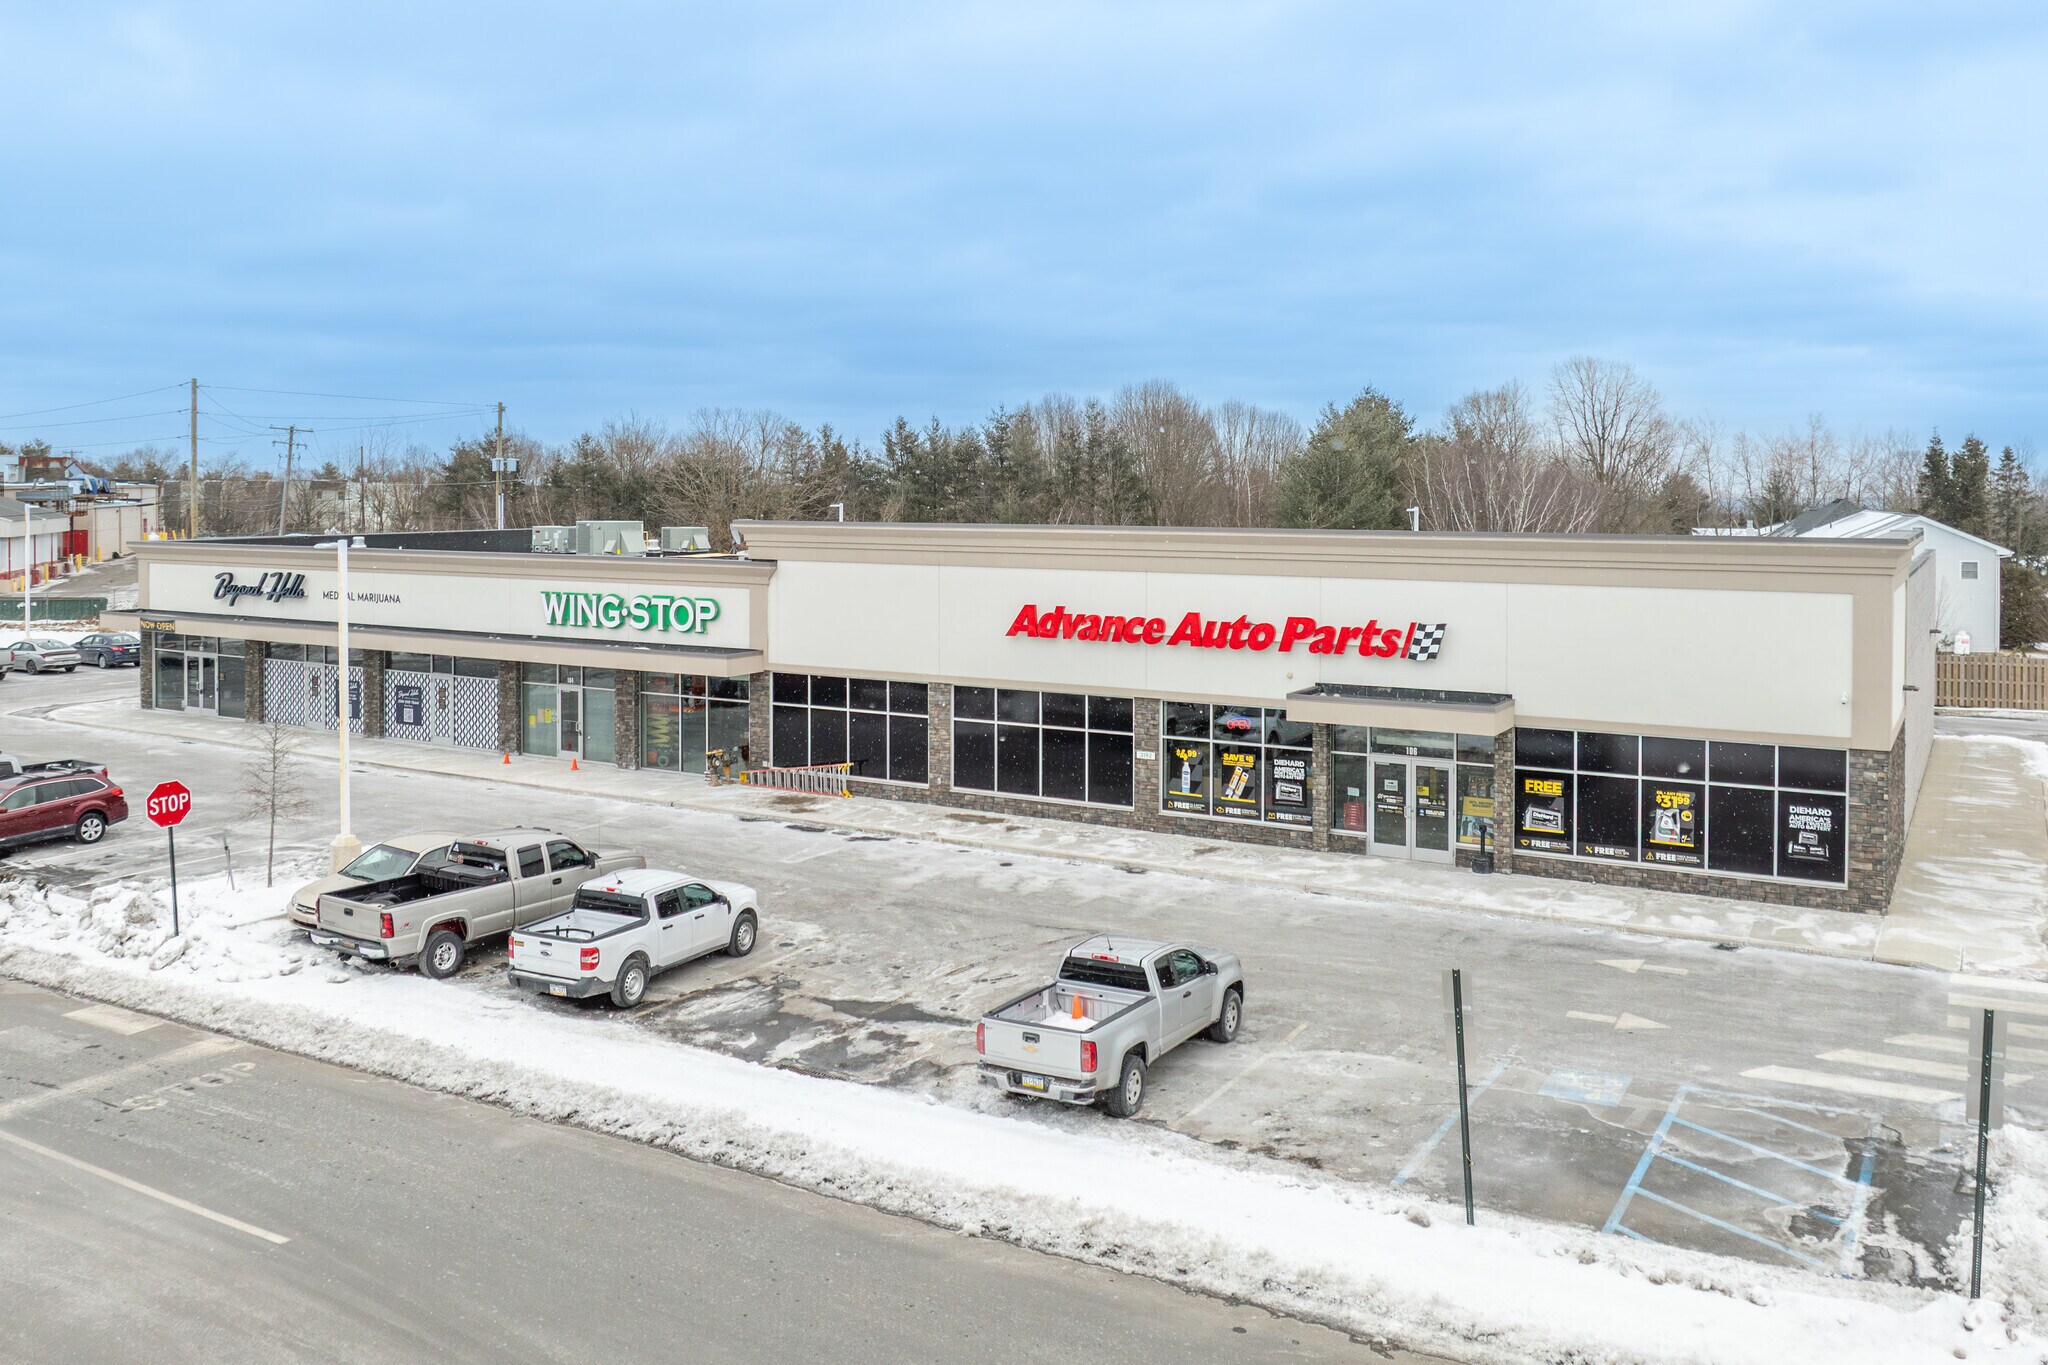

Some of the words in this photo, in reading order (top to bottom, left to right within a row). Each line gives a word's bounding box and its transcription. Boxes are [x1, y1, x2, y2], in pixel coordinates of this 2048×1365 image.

[213, 572, 268, 607] Beyond
[266, 571, 307, 602] Hello
[322, 590, 355, 602] MEDAL
[357, 592, 401, 604] MARIJUANA
[141, 618, 155, 629] NOW
[156, 620, 175, 631] OPEN
[1005, 604, 1167, 645] Advance
[1166, 612, 1276, 652] Auto
[1278, 617, 1402, 659] Parts
[1226, 719, 1251, 730] OPEN
[1406, 746, 1418, 756] 106
[1223, 753, 1245, 762] SAVE
[1273, 758, 1305, 768] DIEHARD
[1525, 779, 1562, 793] FREE
[149, 792, 189, 816] STOP
[1174, 801, 1190, 809] FREE
[1225, 806, 1241, 815] FREE
[1789, 805, 1832, 817] DIEHARD
[1276, 812, 1292, 821] FREE
[1789, 814, 1831, 823] AMERICA'S
[1531, 839, 1551, 849] FREE
[1594, 846, 1615, 856] FREE
[1655, 852, 1676, 862] FREE
[121, 1061, 257, 1111] STOP
